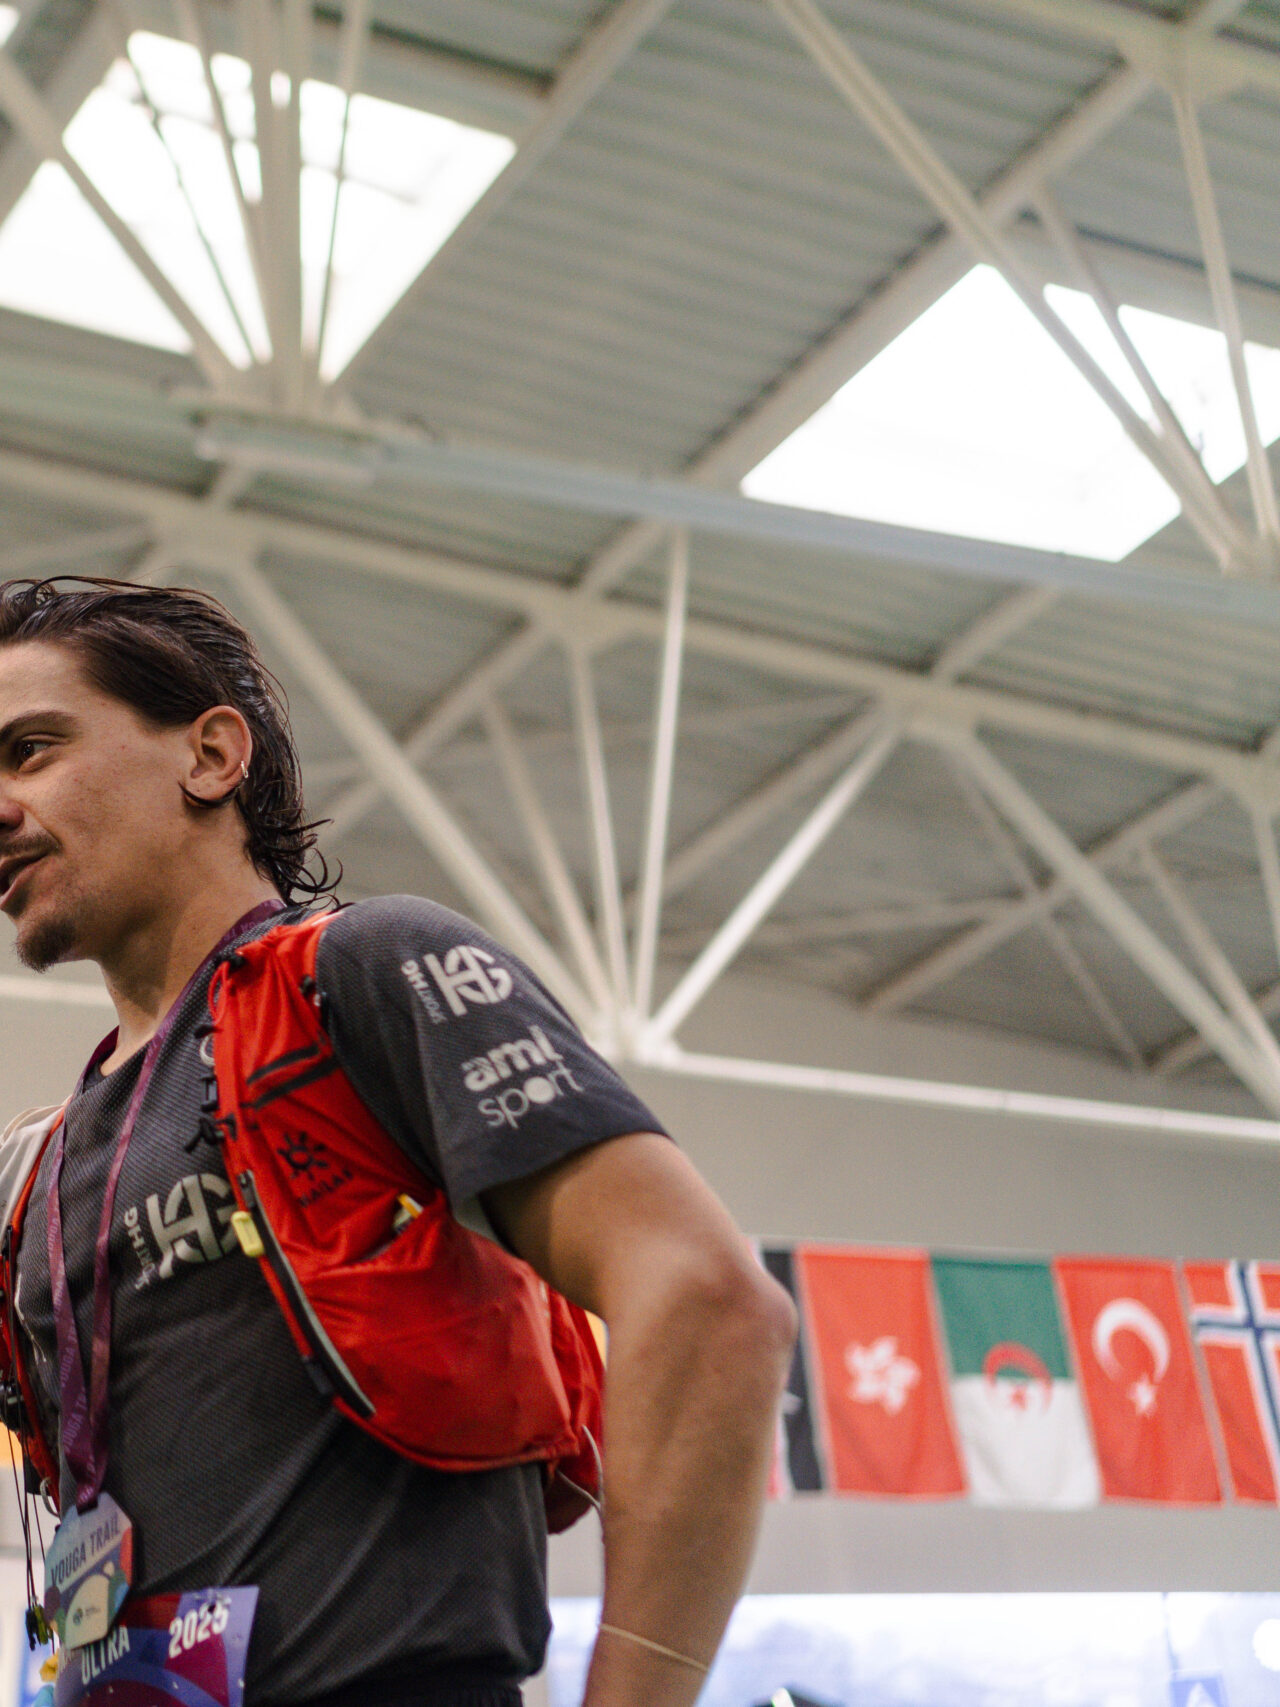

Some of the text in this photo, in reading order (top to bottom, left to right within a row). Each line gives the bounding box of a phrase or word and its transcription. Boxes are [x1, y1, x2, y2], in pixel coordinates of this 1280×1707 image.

[478, 1061, 584, 1129] sport
[50, 1511, 119, 1587] VOUGA TRAIL
[169, 1596, 232, 1659] 2025
